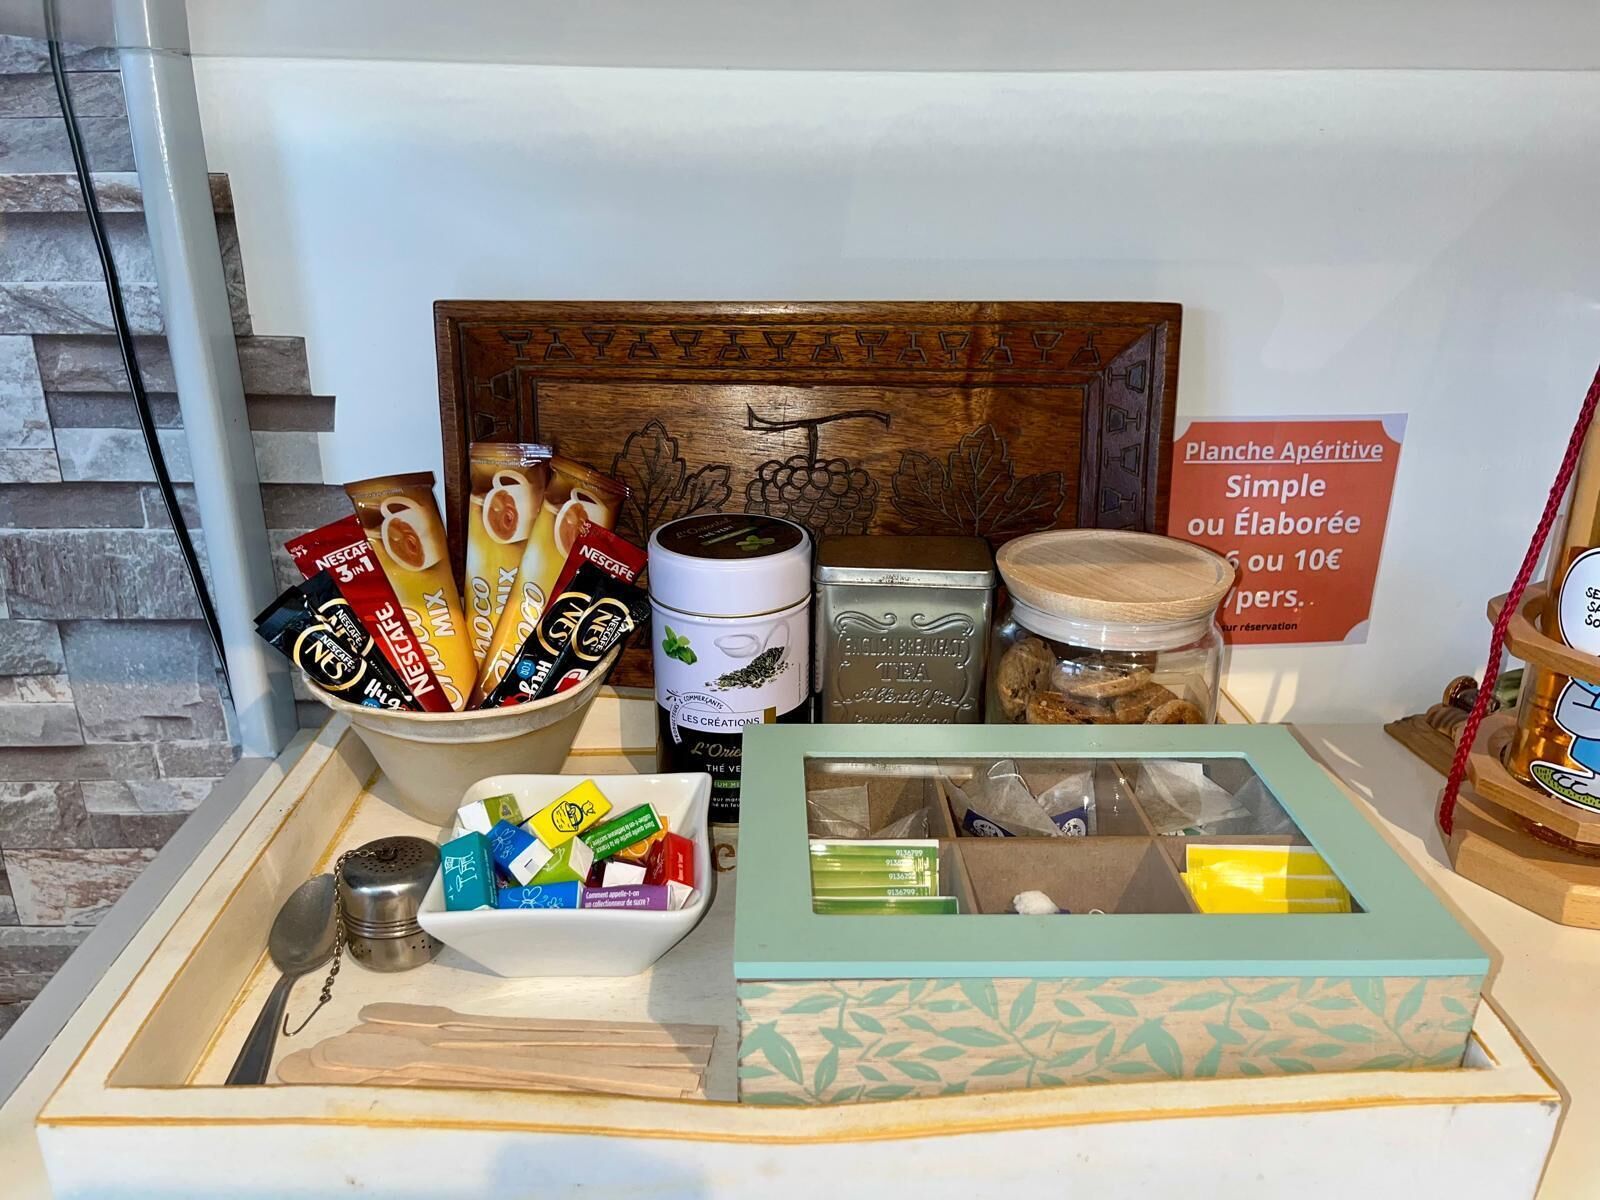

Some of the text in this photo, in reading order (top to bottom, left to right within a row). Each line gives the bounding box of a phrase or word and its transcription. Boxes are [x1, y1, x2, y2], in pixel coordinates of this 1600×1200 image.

[1185, 441, 1383, 464] Planche Apéritive
[1225, 473, 1326, 504] Simple
[1187, 507, 1361, 536] ou Élaborée
[1248, 554, 1283, 572] ou
[1295, 548, 1343, 571] 10€
[423, 588, 455, 637] MIX
[1240, 622, 1297, 633] réservation
[845, 638, 965, 657] ENGLISH BREAKFAST
[305, 640, 348, 680] NES
[876, 662, 932, 682] TEA
[682, 713, 760, 728] LES CRÉATIONS
[706, 763, 725, 773] THÉ
[585, 891, 608, 899] Comment
[625, 898, 633, 906] de
[632, 898, 646, 906] sucre
